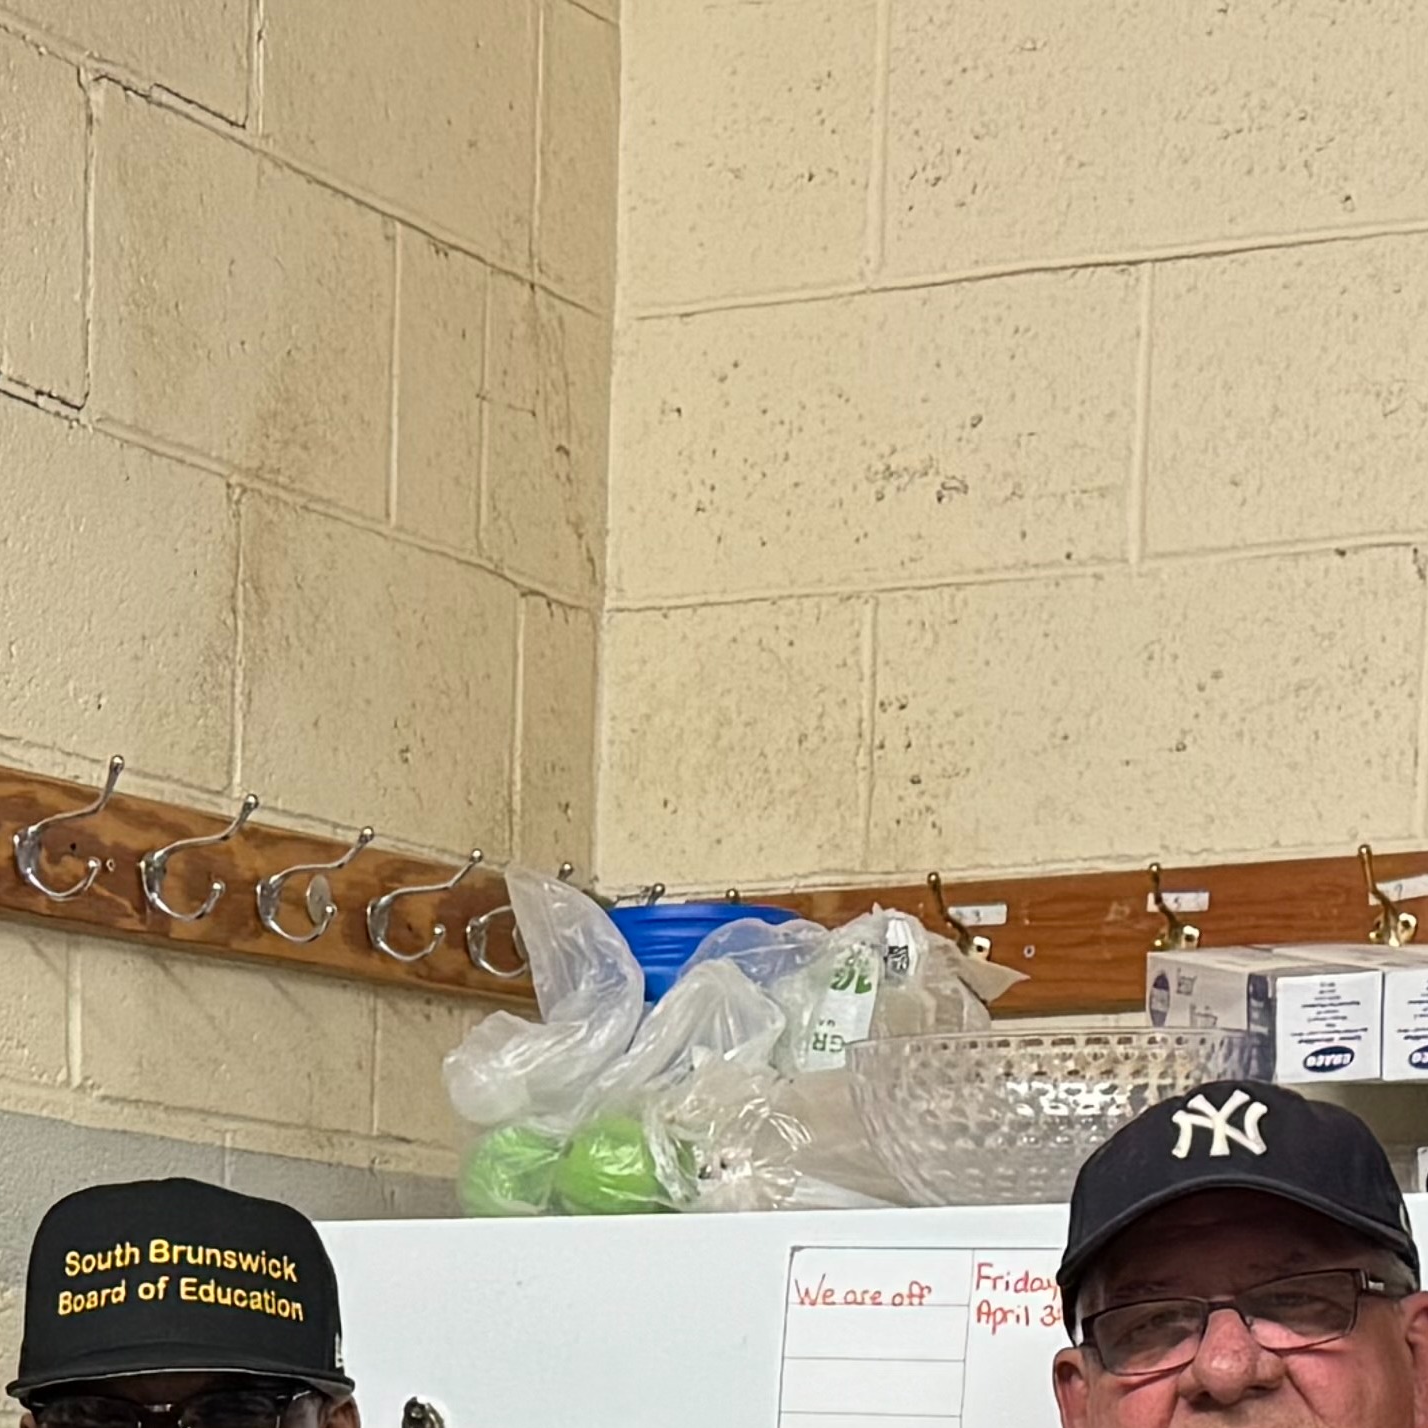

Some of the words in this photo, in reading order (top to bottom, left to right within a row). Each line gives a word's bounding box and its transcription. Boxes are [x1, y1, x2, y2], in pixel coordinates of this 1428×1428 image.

[1172, 1089, 1269, 1160] NY
[64, 1241, 140, 1278] South
[149, 1238, 299, 1283] Brunswick
[976, 1262, 1058, 1301] Friday
[58, 1279, 126, 1316] Board
[138, 1276, 169, 1300] of
[180, 1277, 304, 1322] Education
[794, 1273, 837, 1306] We
[844, 1288, 883, 1306] are
[891, 1280, 933, 1307] off
[976, 1299, 1030, 1335] April
